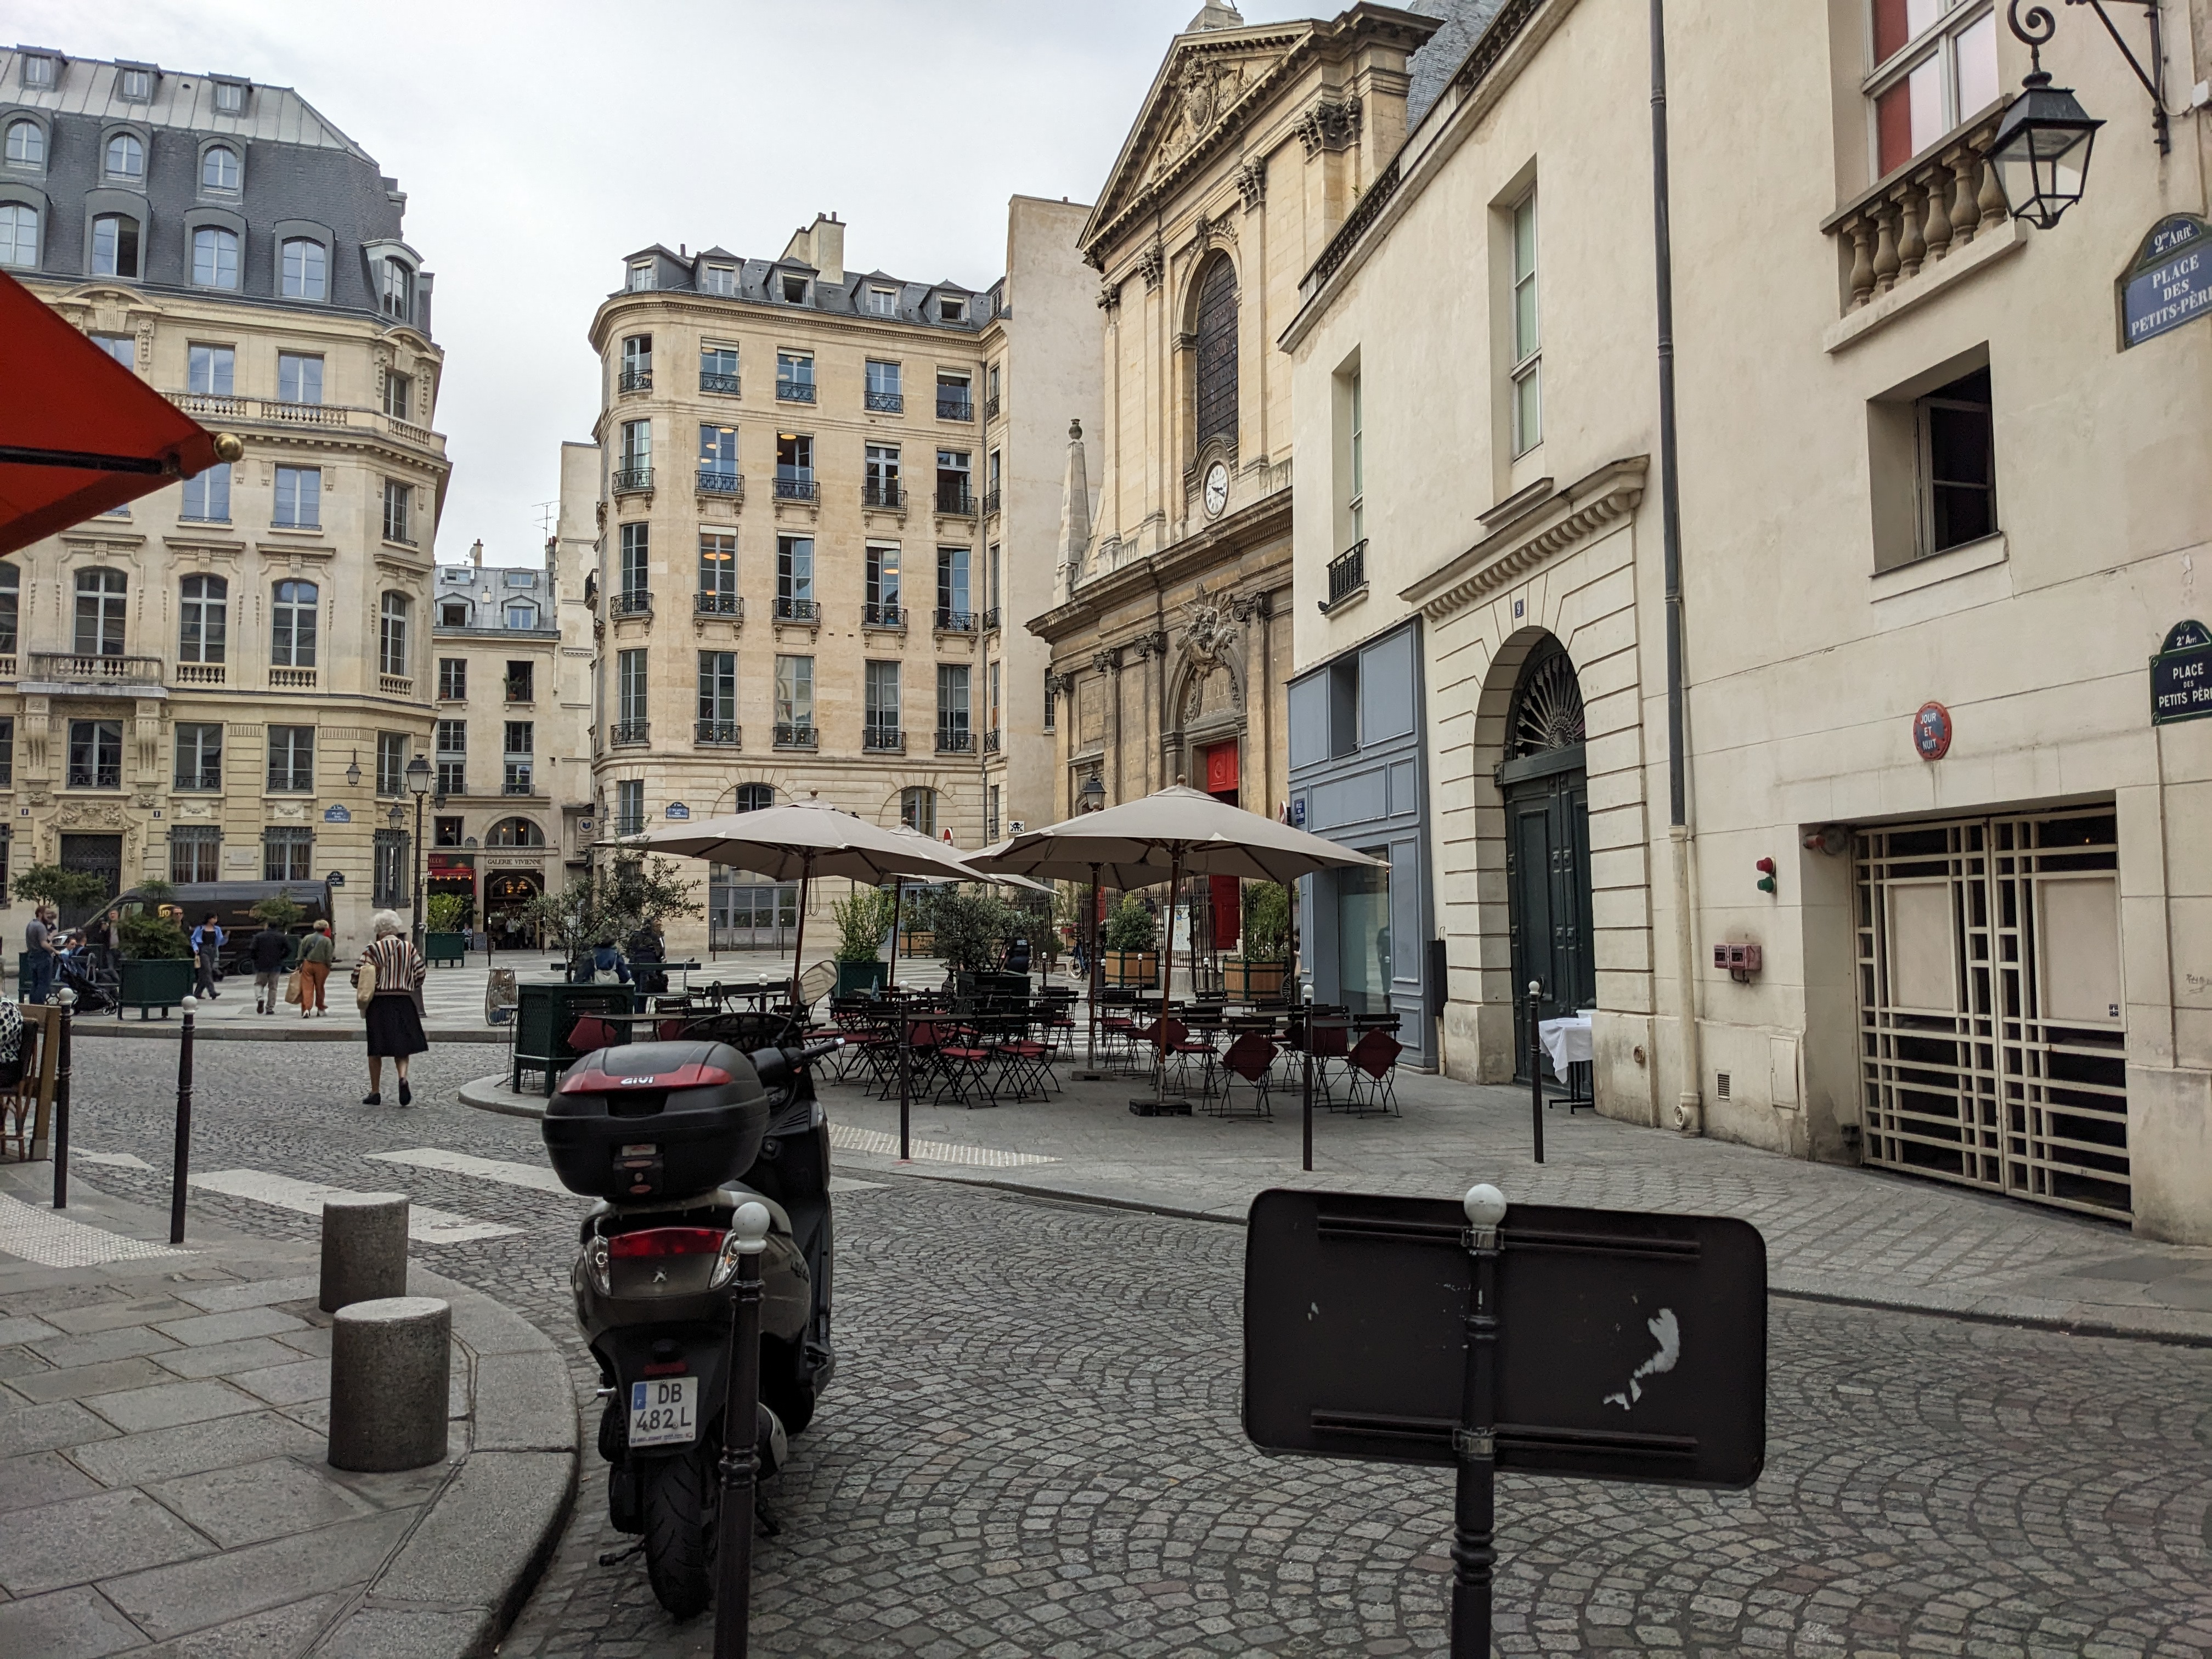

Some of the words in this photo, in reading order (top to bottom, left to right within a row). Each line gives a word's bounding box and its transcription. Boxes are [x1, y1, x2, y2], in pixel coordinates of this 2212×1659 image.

[2153, 254, 2199, 289] PLACE
[2163, 279, 2189, 301] DES
[1516, 602, 1521, 614] 9
[2172, 663, 2204, 680] PLACE
[2183, 680, 2194, 689] DES
[2159, 692, 2187, 708] PETITS
[1921, 713, 1936, 724] JOUR
[1924, 726, 1932, 737] ET
[1922, 738, 1936, 751] NUIT
[620, 1076, 654, 1085] GIVI
[658, 1383, 682, 1404] DB
[636, 1408, 674, 1430] 482
[681, 1407, 691, 1427] L
